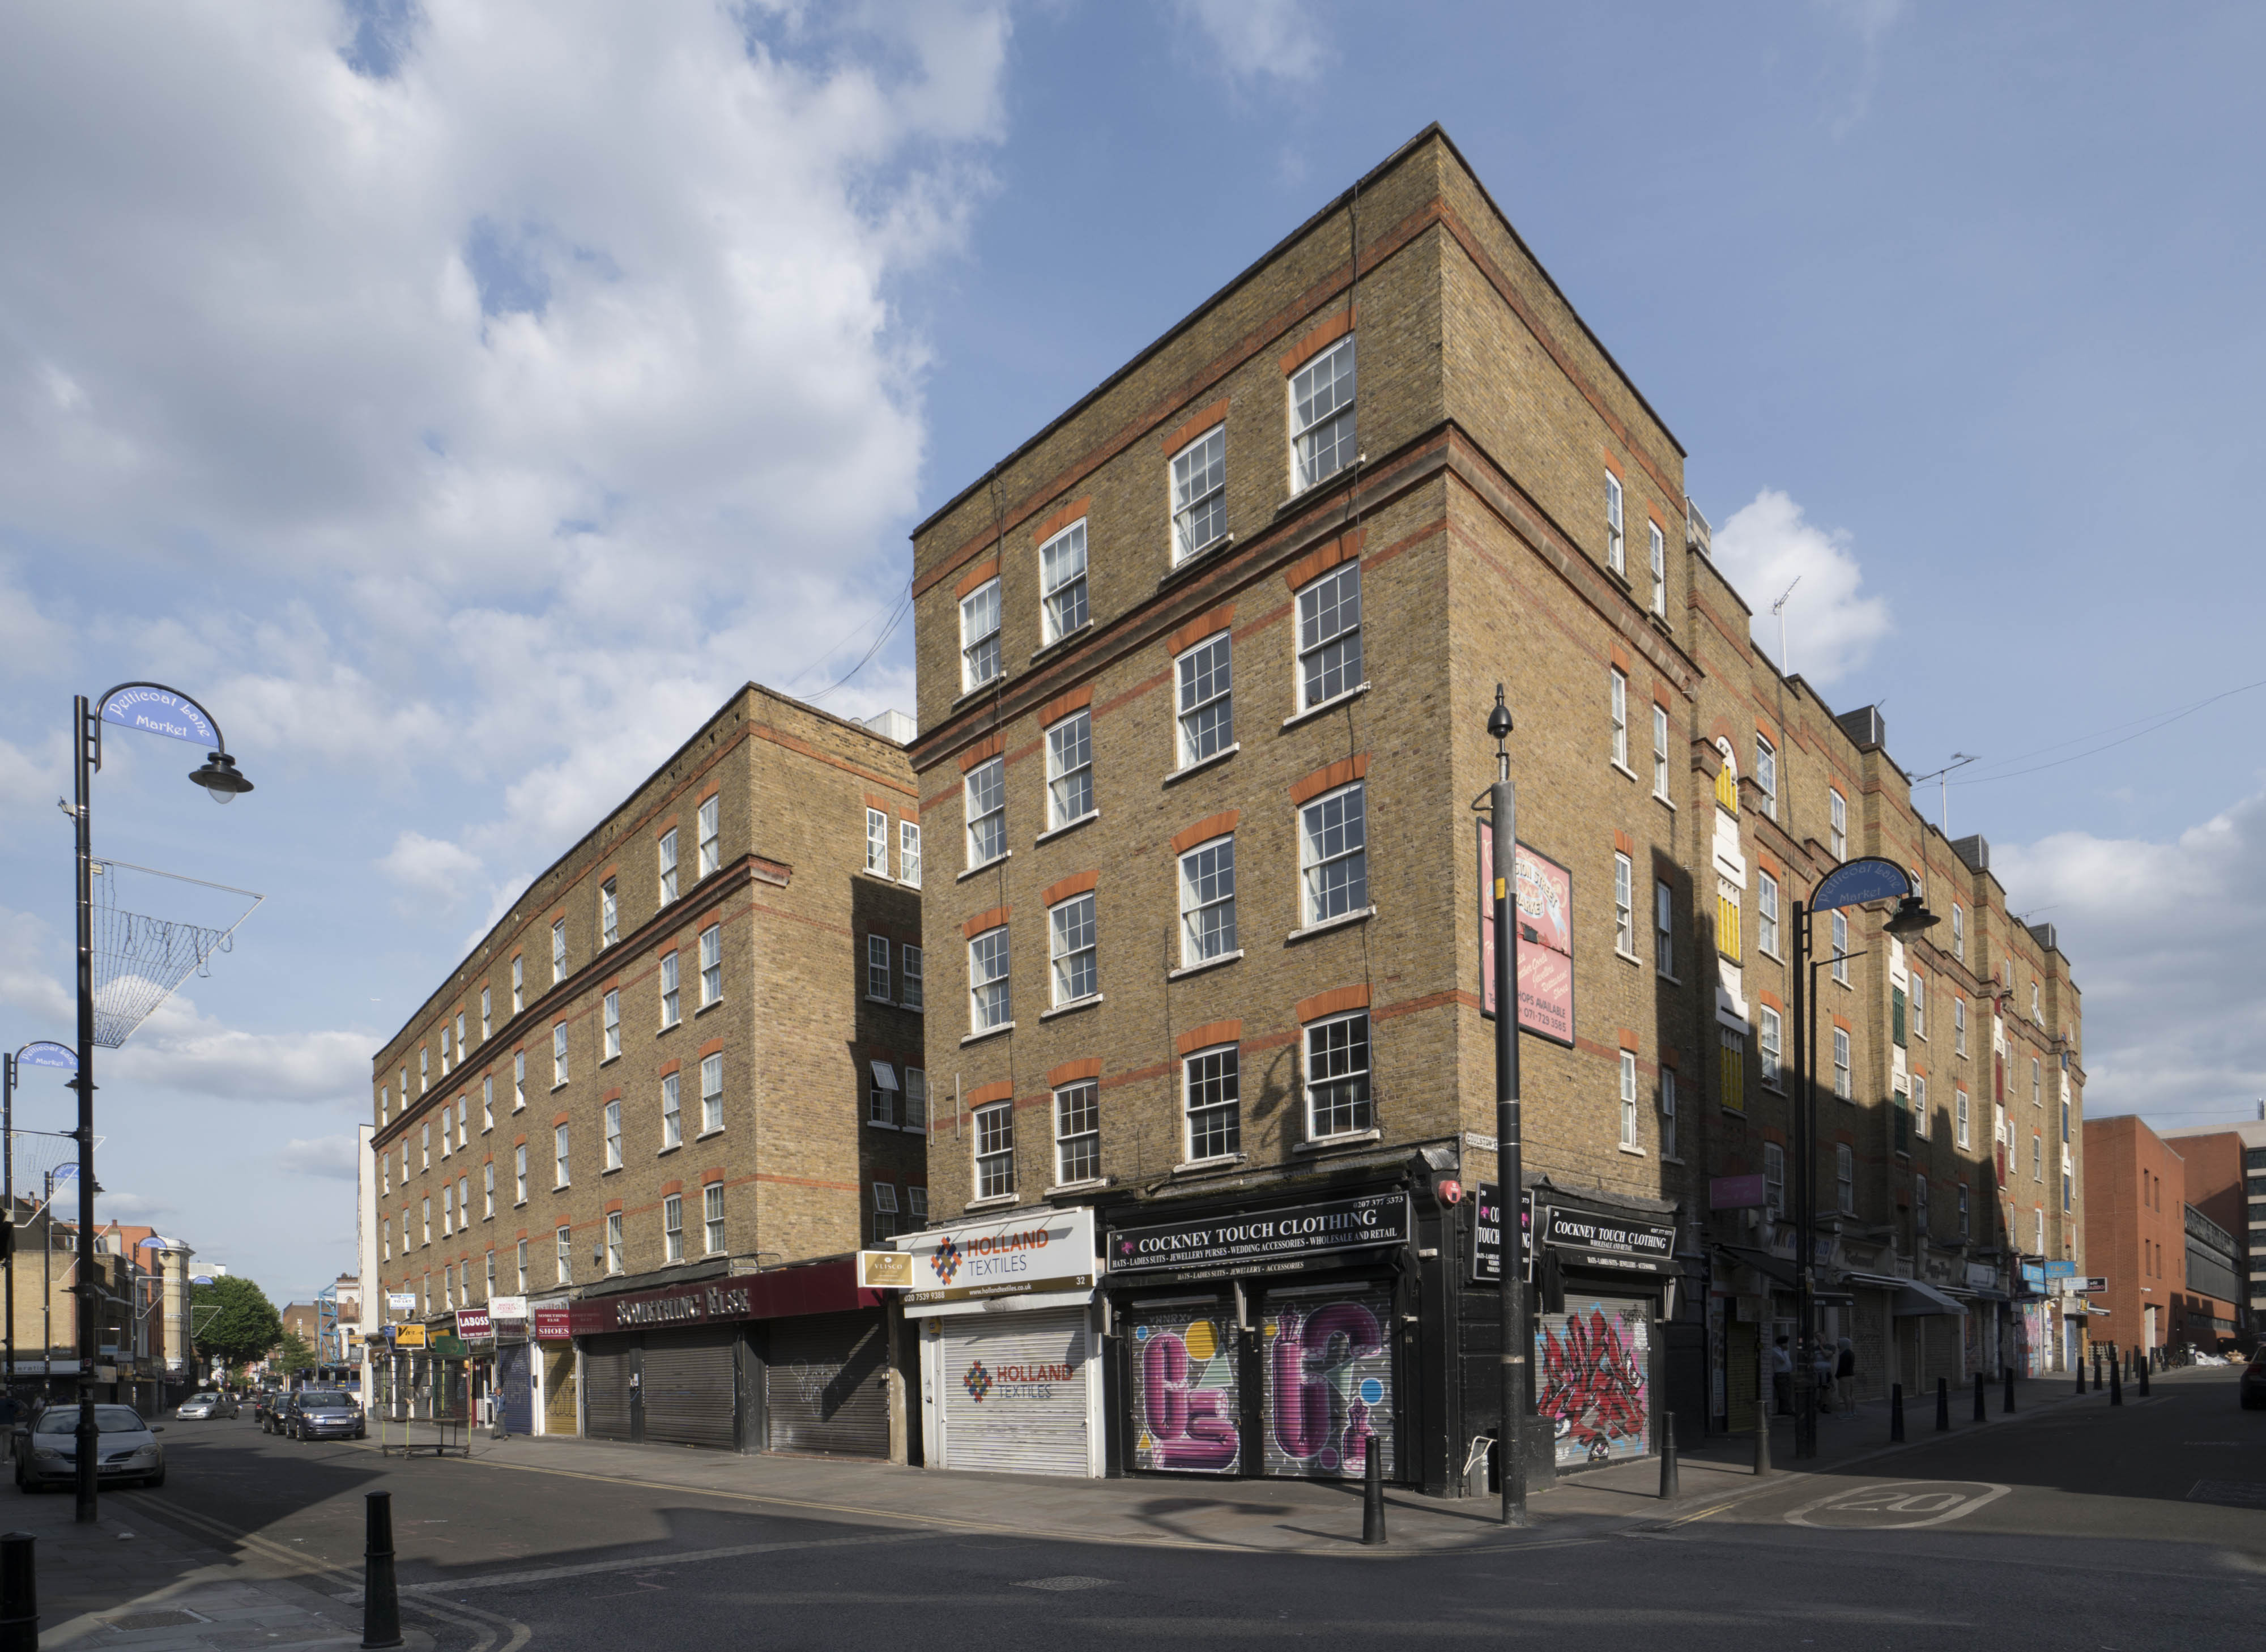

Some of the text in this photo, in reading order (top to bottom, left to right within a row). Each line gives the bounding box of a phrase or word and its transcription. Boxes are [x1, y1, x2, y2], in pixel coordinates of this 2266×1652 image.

[109, 690, 210, 736] Petticoat Lane
[136, 714, 187, 736] Market
[1818, 863, 1901, 902] Petticoat Lane
[1840, 887, 1881, 903] Market
[1518, 990, 1565, 1018] HOPS AVAILABLE
[1551, 1020, 1566, 1032] 3585
[36, 1057, 63, 1066] Market
[1371, 1198, 1383, 1206] 377
[1139, 1209, 1377, 1253] COCKNEY TOUCH CLOTHING
[1478, 1227, 1500, 1245] TOUCH
[1555, 1221, 1666, 1249] COCKNEY TOUCH CLOTHING
[968, 1229, 1049, 1257] HOLLAND
[1113, 1259, 1126, 1268] HATS
[1130, 1257, 1149, 1266] LADIES
[1150, 1254, 1166, 1263] SUITS
[1170, 1250, 1204, 1262] JEWELLERY
[1205, 1247, 1226, 1259] PURSES
[1231, 1244, 1260, 1254] WEDDING
[1261, 1238, 1305, 1251] ACCESSORIES
[1310, 1232, 1353, 1245] WHOLESALE
[1354, 1231, 1369, 1240] AND
[1370, 1228, 1397, 1239] RETAIL
[968, 1254, 1027, 1276] TEXTILES
[1266, 1262, 1304, 1272] ACCESSORIES
[969, 1276, 1085, 1296] www.hollandtextiles.co.uk 32
[616, 1294, 701, 1326] SOMETHING
[706, 1287, 751, 1315] ELSE
[904, 1291, 945, 1302] 020 7539 9388
[459, 1315, 489, 1327] LABOSS
[997, 1364, 1074, 1382] HOLLAND
[998, 1384, 1052, 1398] TEXTILES
[1826, 1492, 1966, 1512] 20
